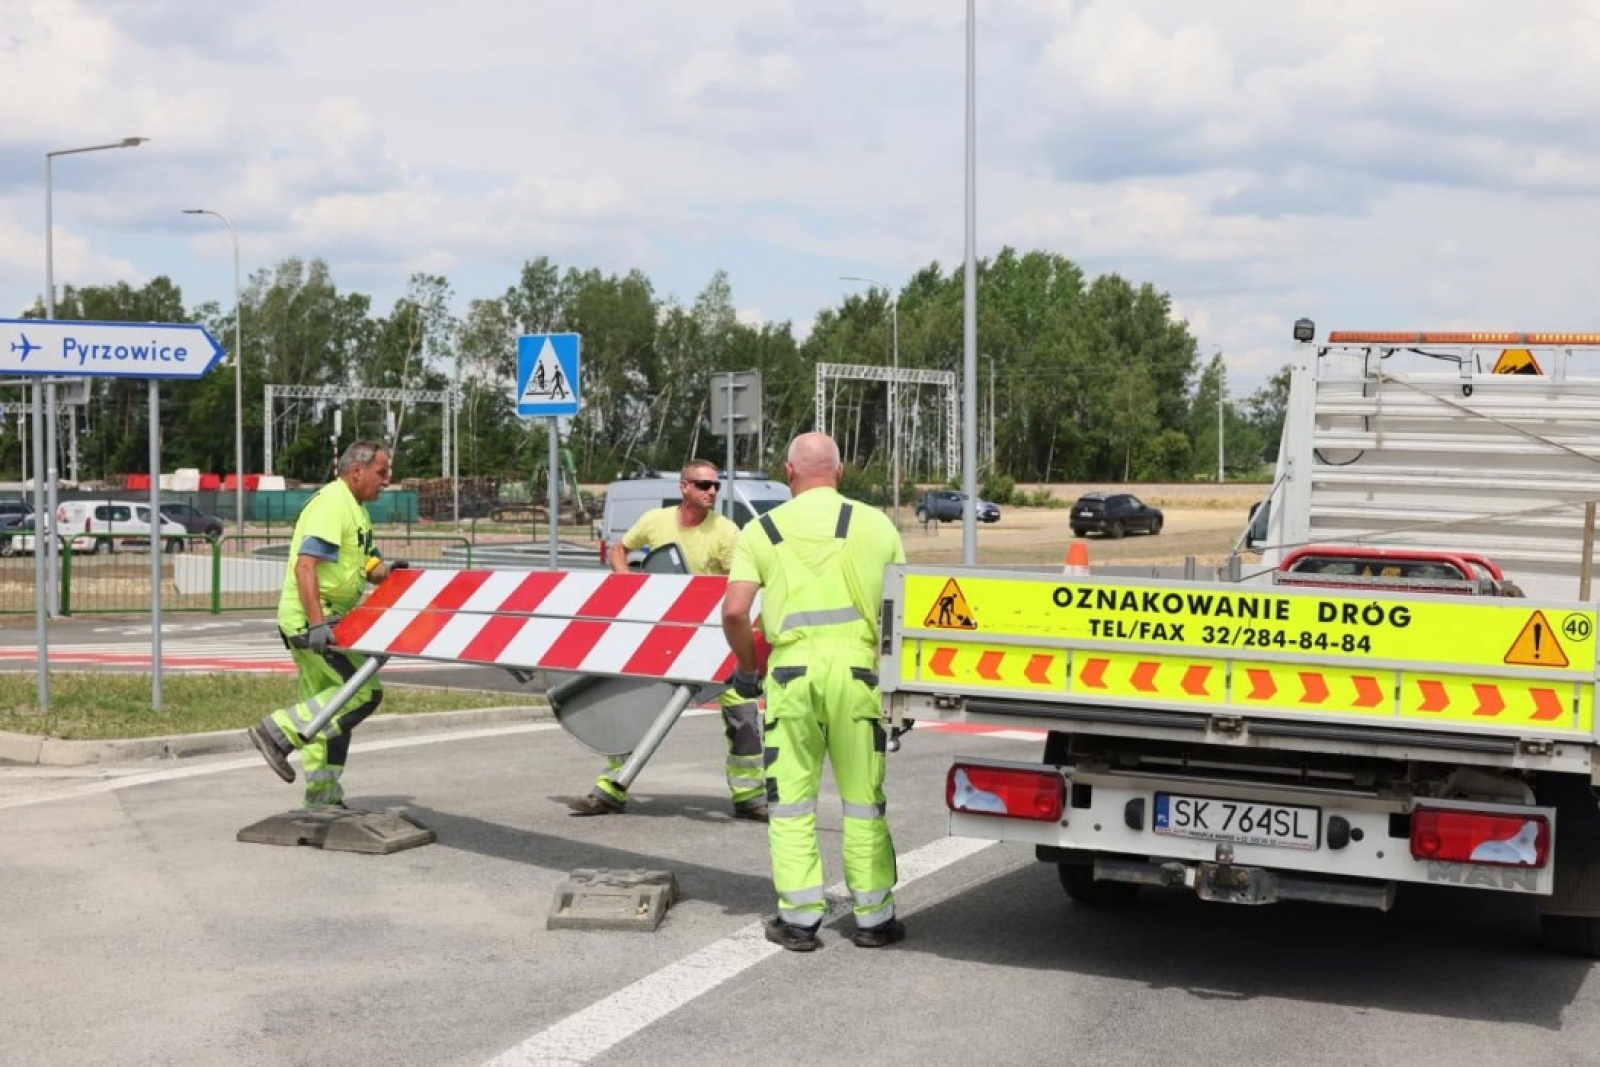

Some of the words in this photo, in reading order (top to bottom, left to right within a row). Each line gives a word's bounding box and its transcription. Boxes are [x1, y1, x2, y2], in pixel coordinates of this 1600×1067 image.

[63, 337, 188, 366] Pyrzowice
[1052, 586, 1290, 620] OZNAKOWANIE
[1317, 601, 1412, 628] DRÓG
[1088, 618, 1185, 642] TEL/FAX
[1202, 625, 1371, 653] 32/284-84-84
[1565, 620, 1589, 636] 40
[1174, 799, 1210, 829] SK
[1222, 804, 1308, 839] 764SL
[1427, 860, 1537, 891] MAN
